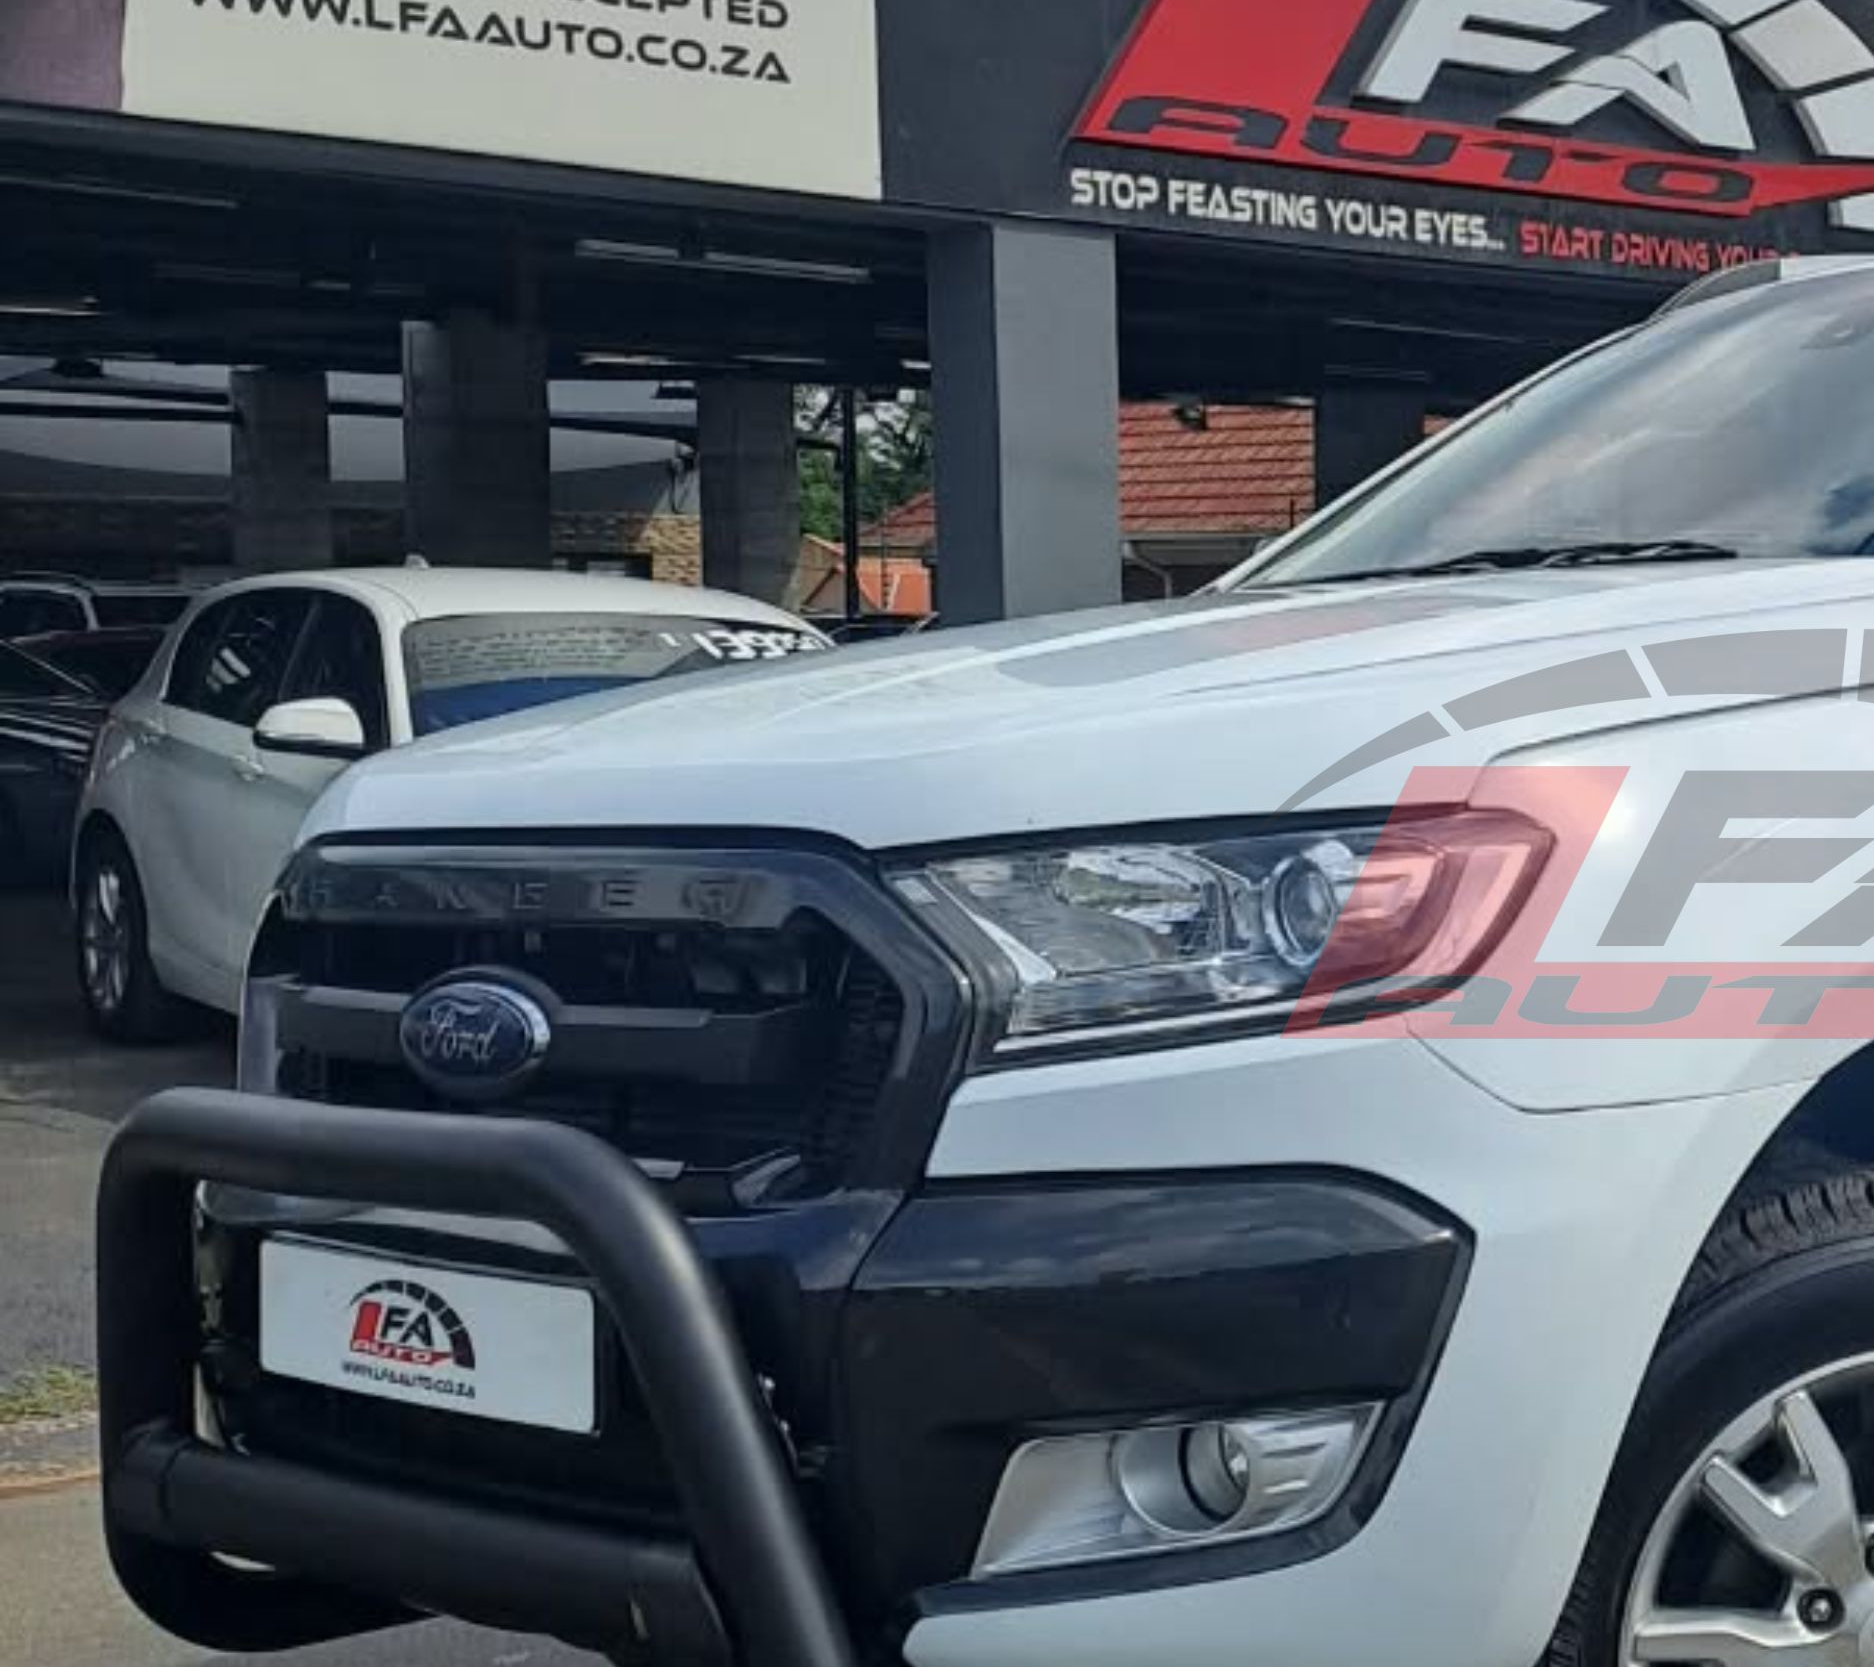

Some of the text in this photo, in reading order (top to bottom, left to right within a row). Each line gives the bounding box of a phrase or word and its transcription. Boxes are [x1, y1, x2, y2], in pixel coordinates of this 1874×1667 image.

[1105, 94, 1758, 208] AUTO
[1070, 167, 1159, 211] STOP
[1167, 178, 1318, 231] FEASTING
[1325, 198, 1409, 241] YOUR
[1413, 205, 1506, 252] EYES...
[1519, 220, 1605, 263] START
[1611, 228, 1711, 272] DRIVING
[420, 998, 499, 1065] Ford
[352, 1338, 434, 1364] AUTO
